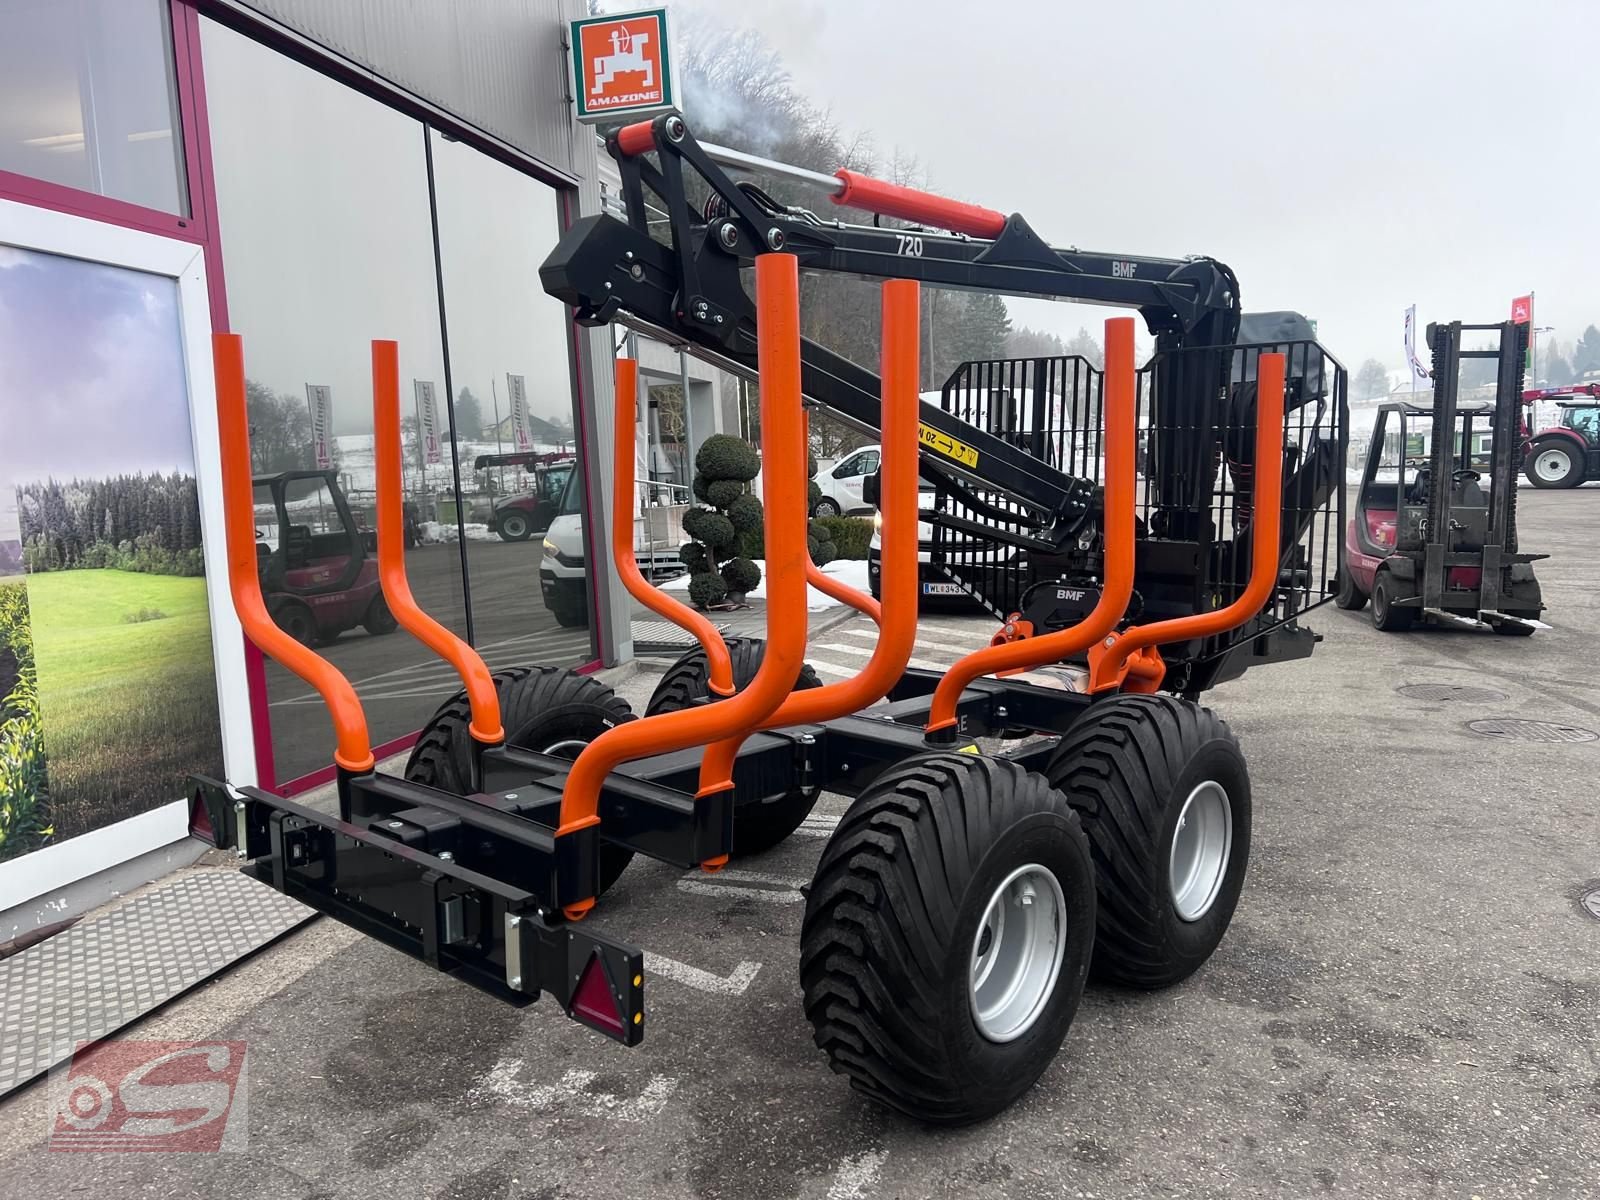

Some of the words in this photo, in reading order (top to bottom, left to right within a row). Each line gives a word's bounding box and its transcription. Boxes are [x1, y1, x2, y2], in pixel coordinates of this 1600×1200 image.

[588, 91, 660, 107] AMAZONE
[896, 234, 923, 257] 720
[1112, 260, 1138, 278] BMF
[926, 431, 936, 444] 20
[930, 585, 940, 593] WL
[1056, 589, 1086, 601] BMF
